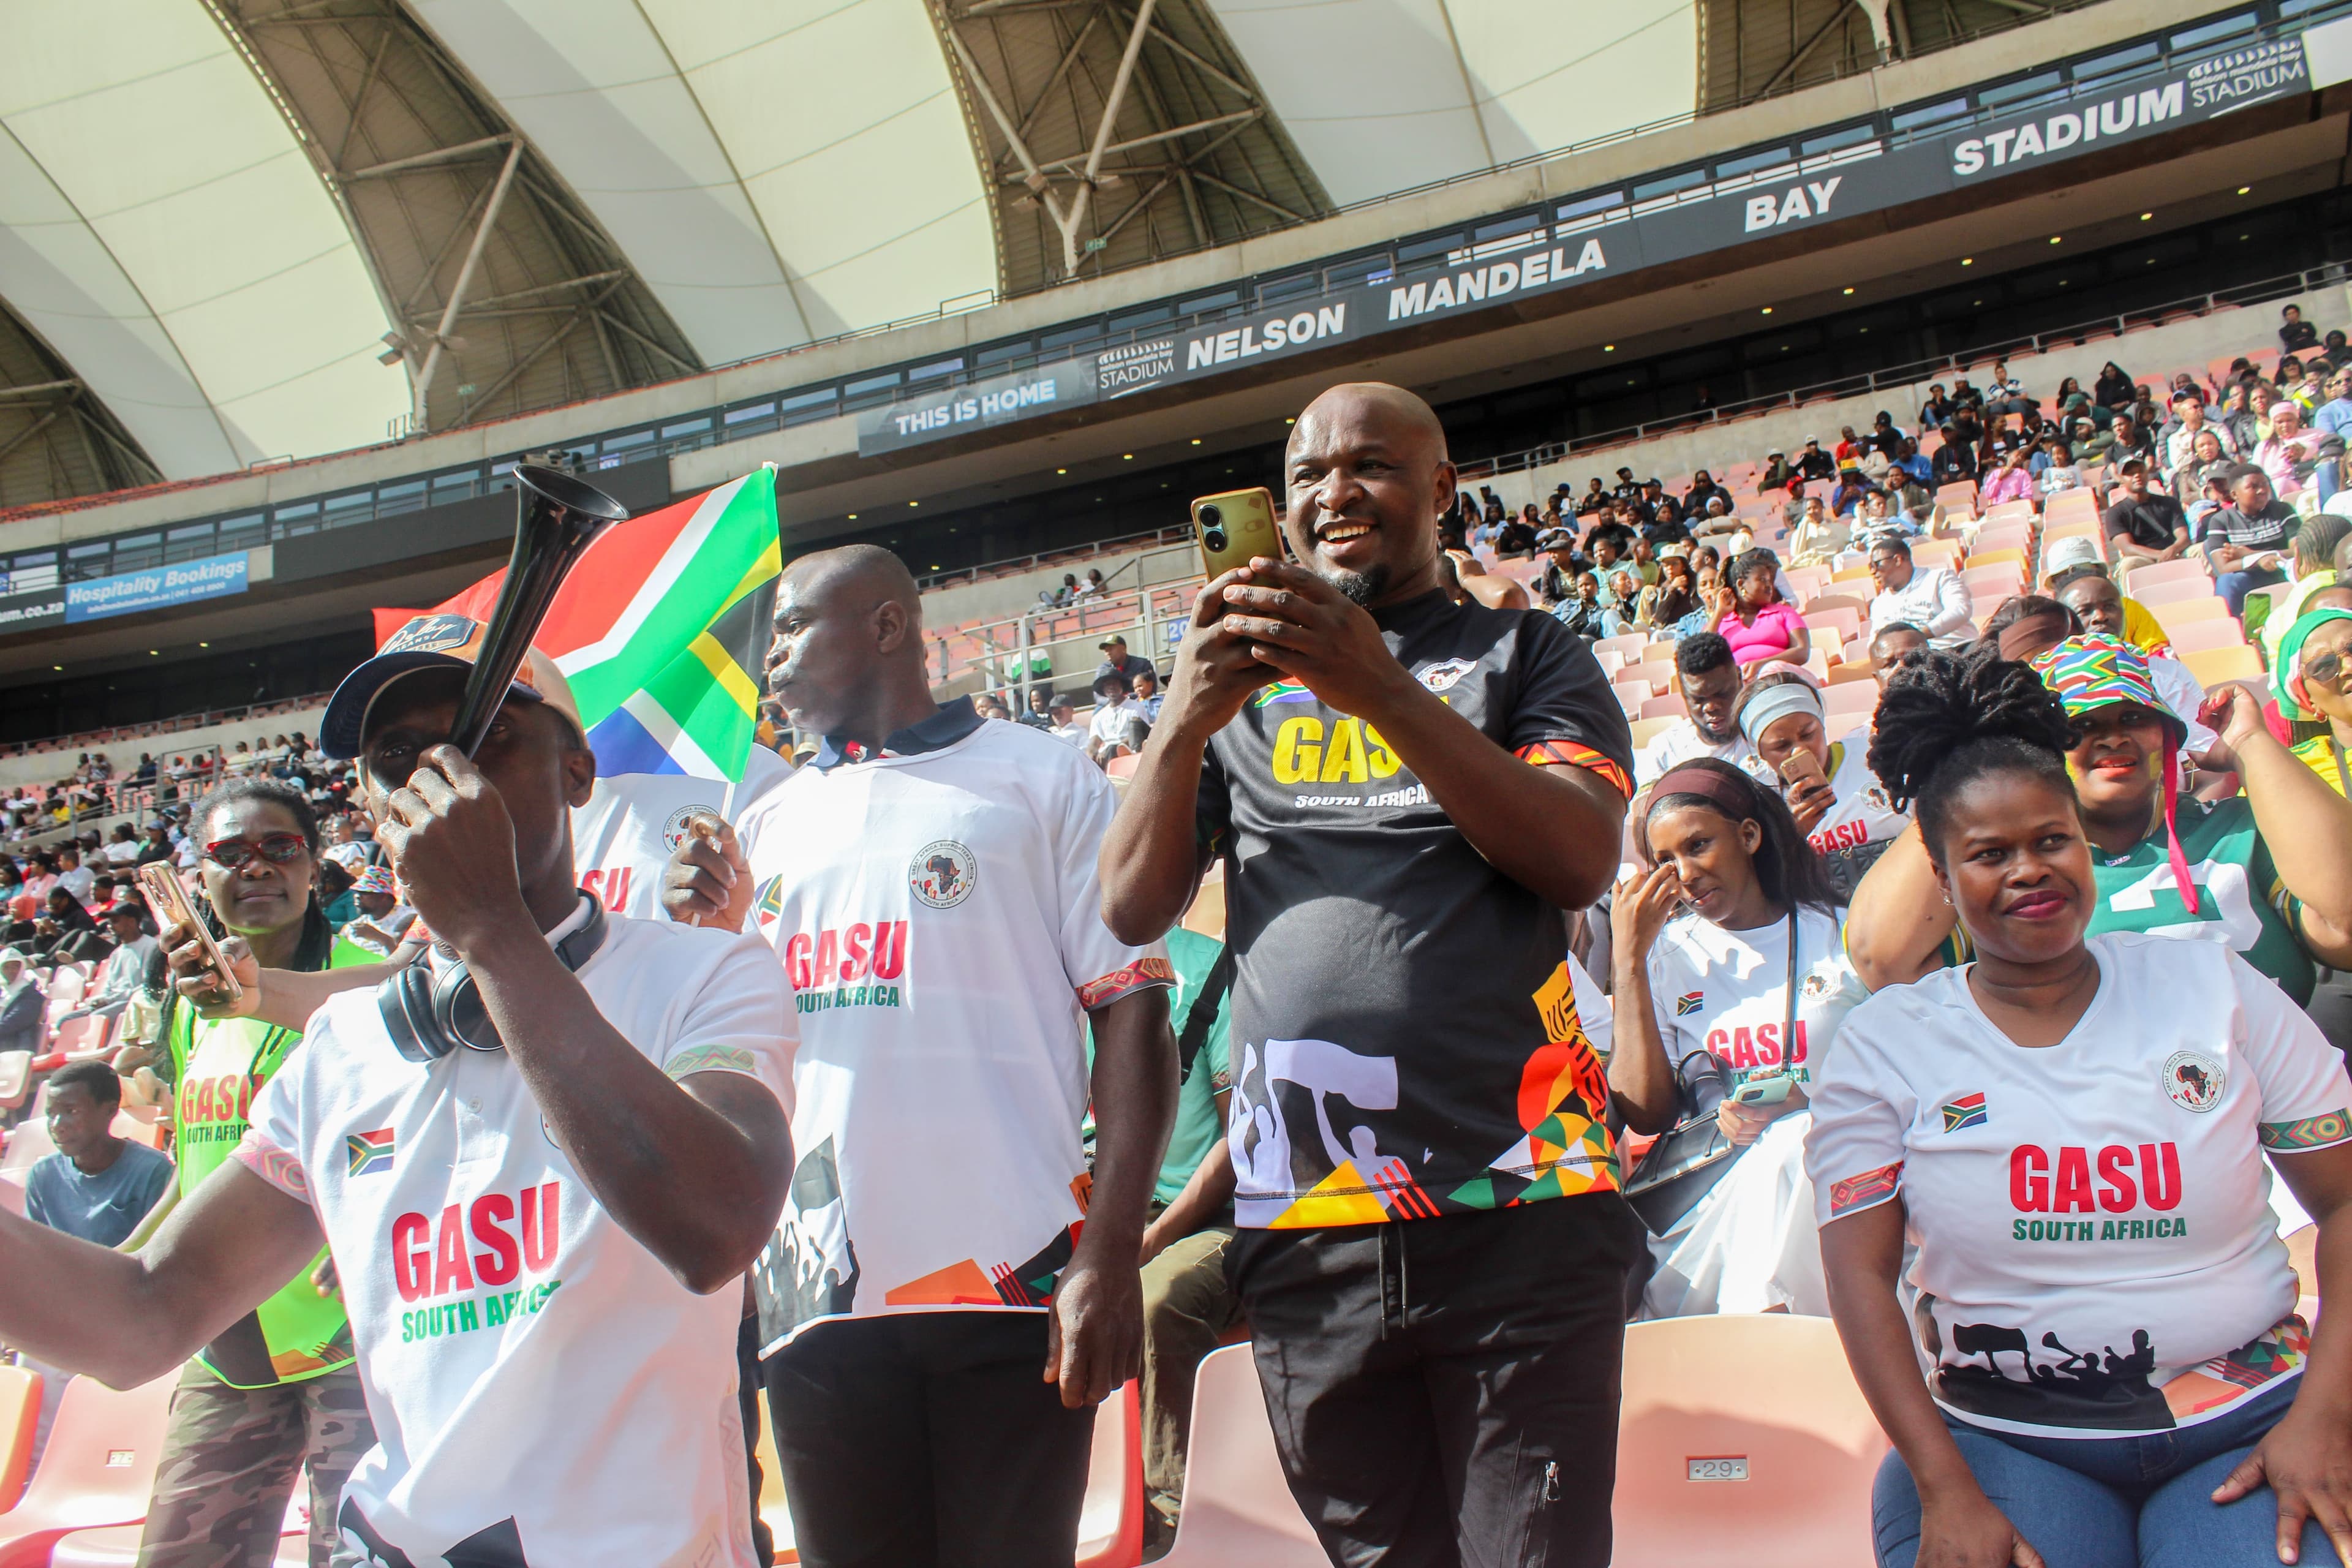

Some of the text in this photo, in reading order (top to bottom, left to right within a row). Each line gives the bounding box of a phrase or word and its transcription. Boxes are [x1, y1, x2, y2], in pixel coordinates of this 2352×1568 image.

[2192, 61, 2305, 107] STADIUM
[1188, 78, 2184, 371] NELSON MANDELA BAY STADIUM
[1100, 358, 1174, 388] STADIUM
[895, 379, 1057, 436] THIS IS HOME
[69, 576, 160, 605] Hospitality
[165, 560, 245, 587] Bookings
[1272, 714, 1406, 785] GAS
[1295, 783, 1429, 809] SOUTH AFRICA
[911, 859, 920, 875] GREAT
[919, 844, 937, 858] AFRICA
[940, 843, 971, 861] SUPPORTERS
[1808, 819, 1868, 856] GASU
[924, 897, 959, 907] SOUTH AFRICA
[785, 921, 908, 991] GASU
[796, 985, 900, 1014] OUTH AFRICA
[1707, 1020, 1807, 1070] GASU
[181, 1074, 265, 1124] GASU
[2010, 1142, 2182, 1213] GASU
[392, 1181, 560, 1303] GASU
[2013, 1217, 2187, 1241] SOUTH AFRICA
[402, 1300, 480, 1343] SOUTH
[1703, 1461, 1733, 1477] 29
